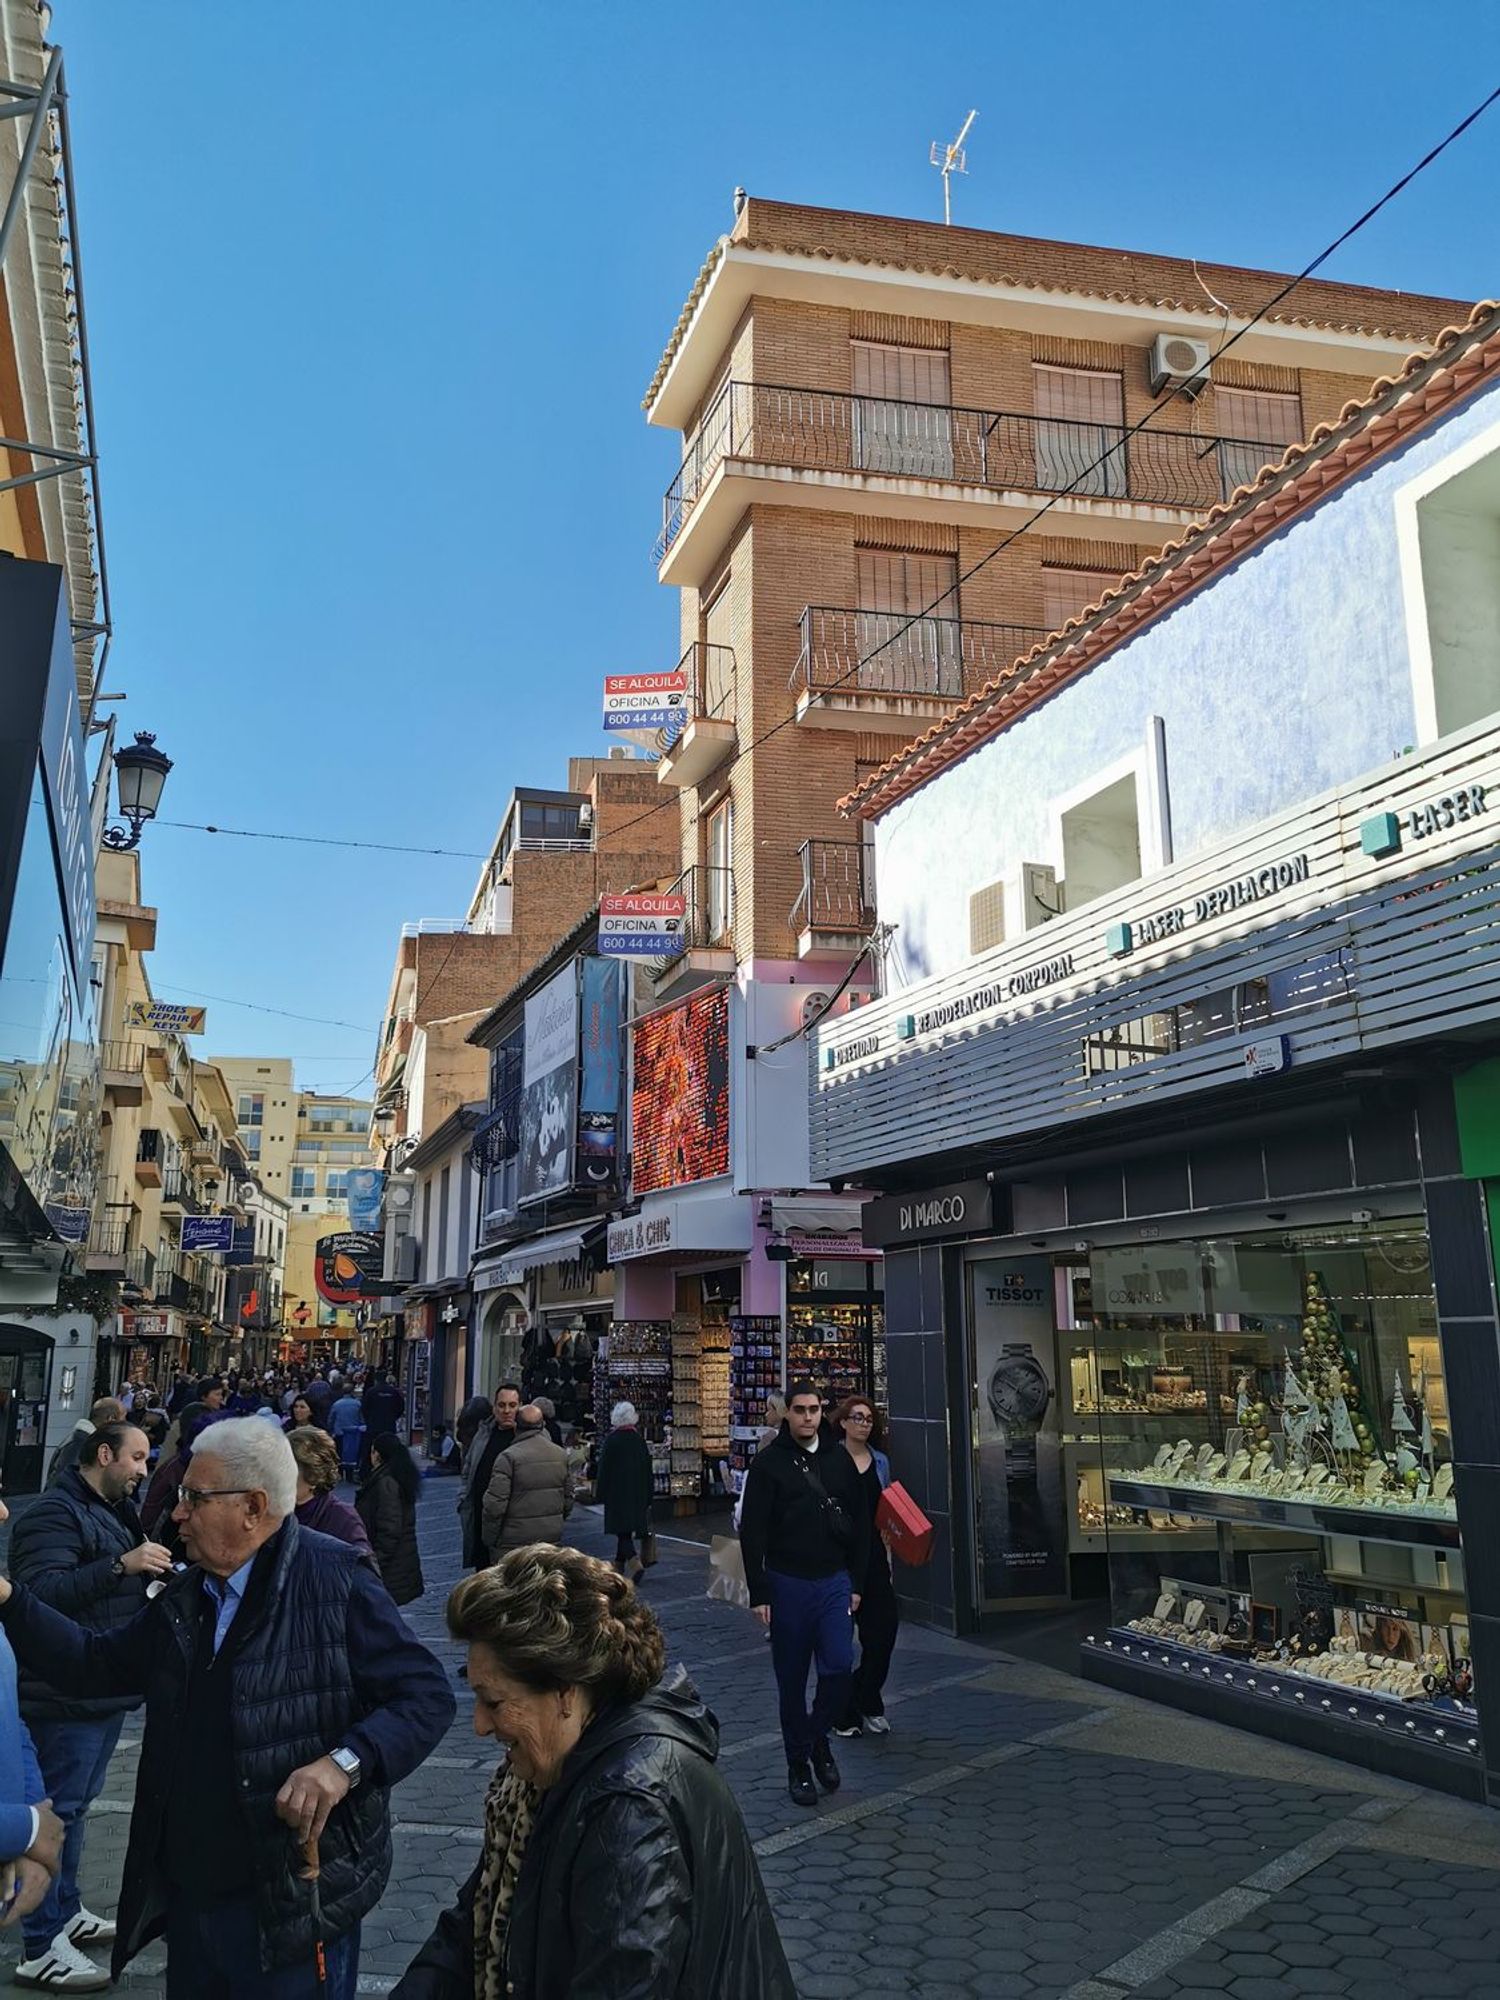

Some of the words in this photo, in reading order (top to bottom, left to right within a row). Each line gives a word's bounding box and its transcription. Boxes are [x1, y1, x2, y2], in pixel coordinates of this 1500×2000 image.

[610, 679, 627, 690] SE
[629, 676, 684, 689] ALQUILA
[609, 696, 660, 708] OFICINA
[608, 714, 630, 724] 600
[632, 713, 647, 723] 44
[650, 712, 664, 722] 44
[1409, 785, 1489, 839] LASER
[605, 899, 623, 911] SE
[625, 899, 682, 911] ALQUILA
[1137, 906, 1185, 946] LASER
[1193, 853, 1310, 922] DEPILACION
[604, 919, 657, 931] OFICINA
[603, 937, 626, 948] 600
[628, 938, 643, 948] 44
[646, 938, 661, 948] 44
[917, 984, 1002, 1033] REMODELACION
[1008, 953, 1076, 998] CORPORAL
[151, 1004, 188, 1014] SHOES
[147, 1012, 190, 1022] REPAIR
[152, 1021, 181, 1030] KEYS
[899, 1205, 912, 1231] DI
[915, 1195, 965, 1228] MARCO
[609, 1227, 634, 1254] CHICA
[646, 1216, 671, 1246] CHIC
[986, 1288, 1045, 1301] TISSOT
